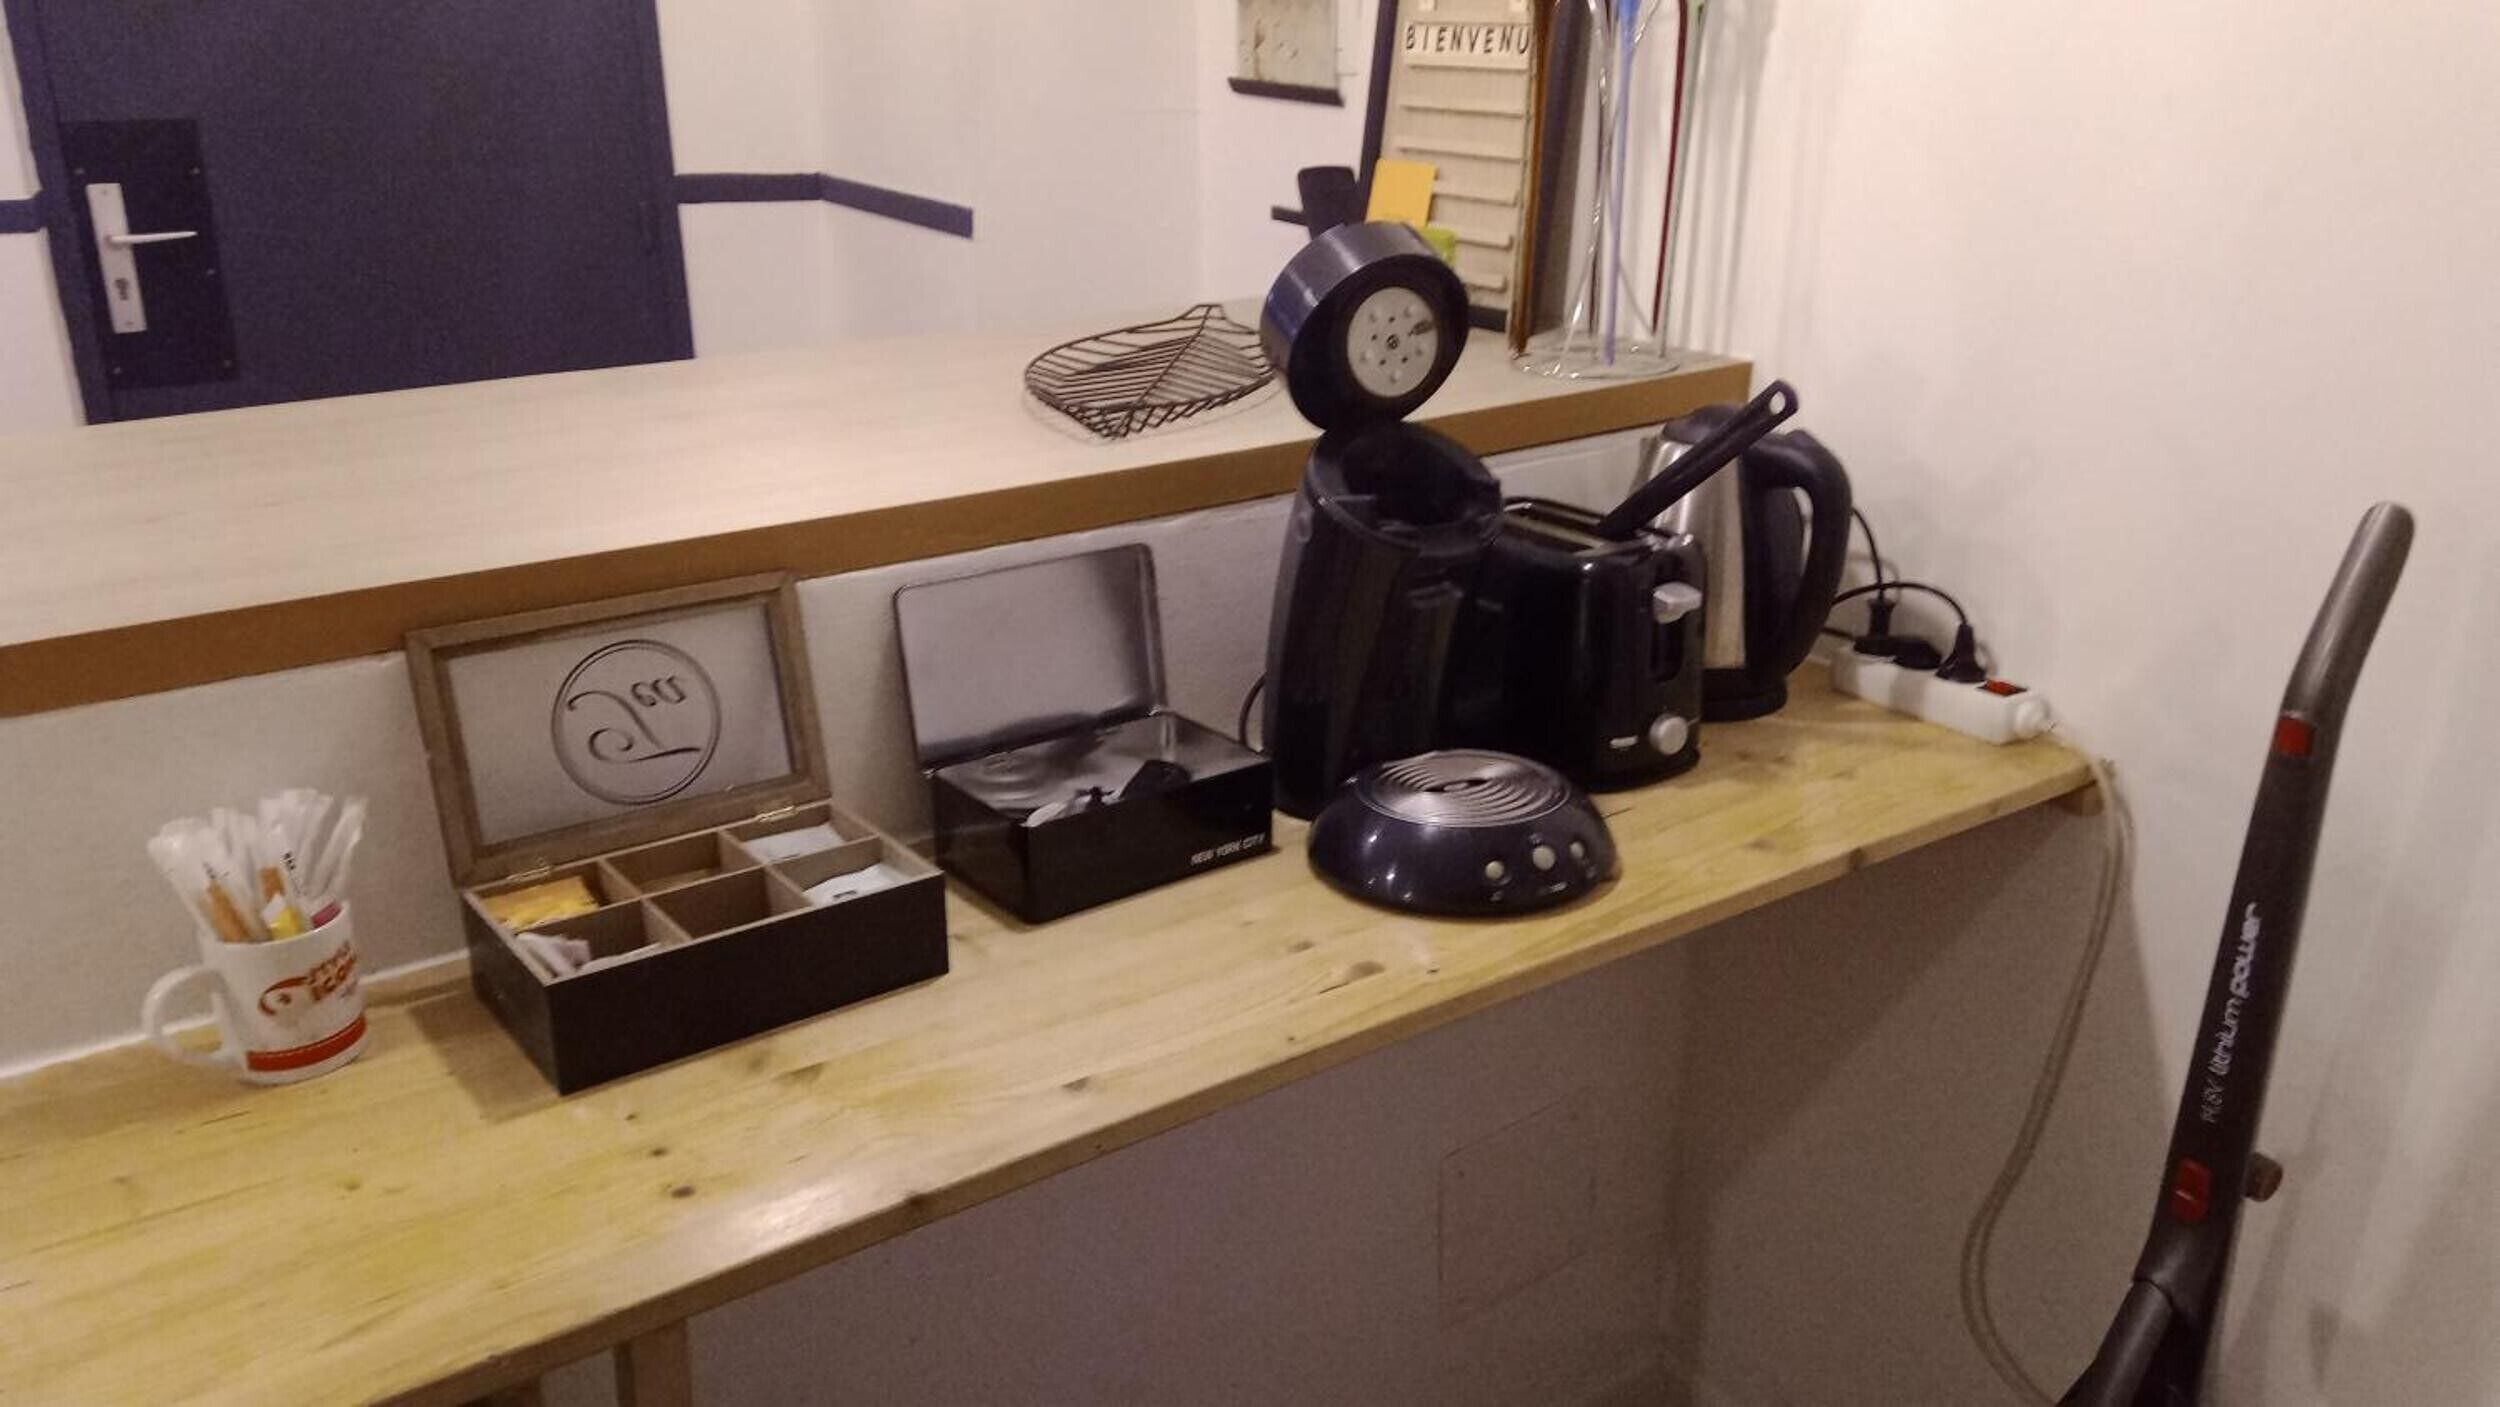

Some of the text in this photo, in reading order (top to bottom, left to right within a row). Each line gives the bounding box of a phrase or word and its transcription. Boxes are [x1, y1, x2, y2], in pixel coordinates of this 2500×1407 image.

[1406, 24, 1529, 54] BIENVENU
[1190, 833, 1265, 865] NEW YORK CITY
[2208, 998, 2242, 1076] lithium
[2230, 903, 2260, 998] power
